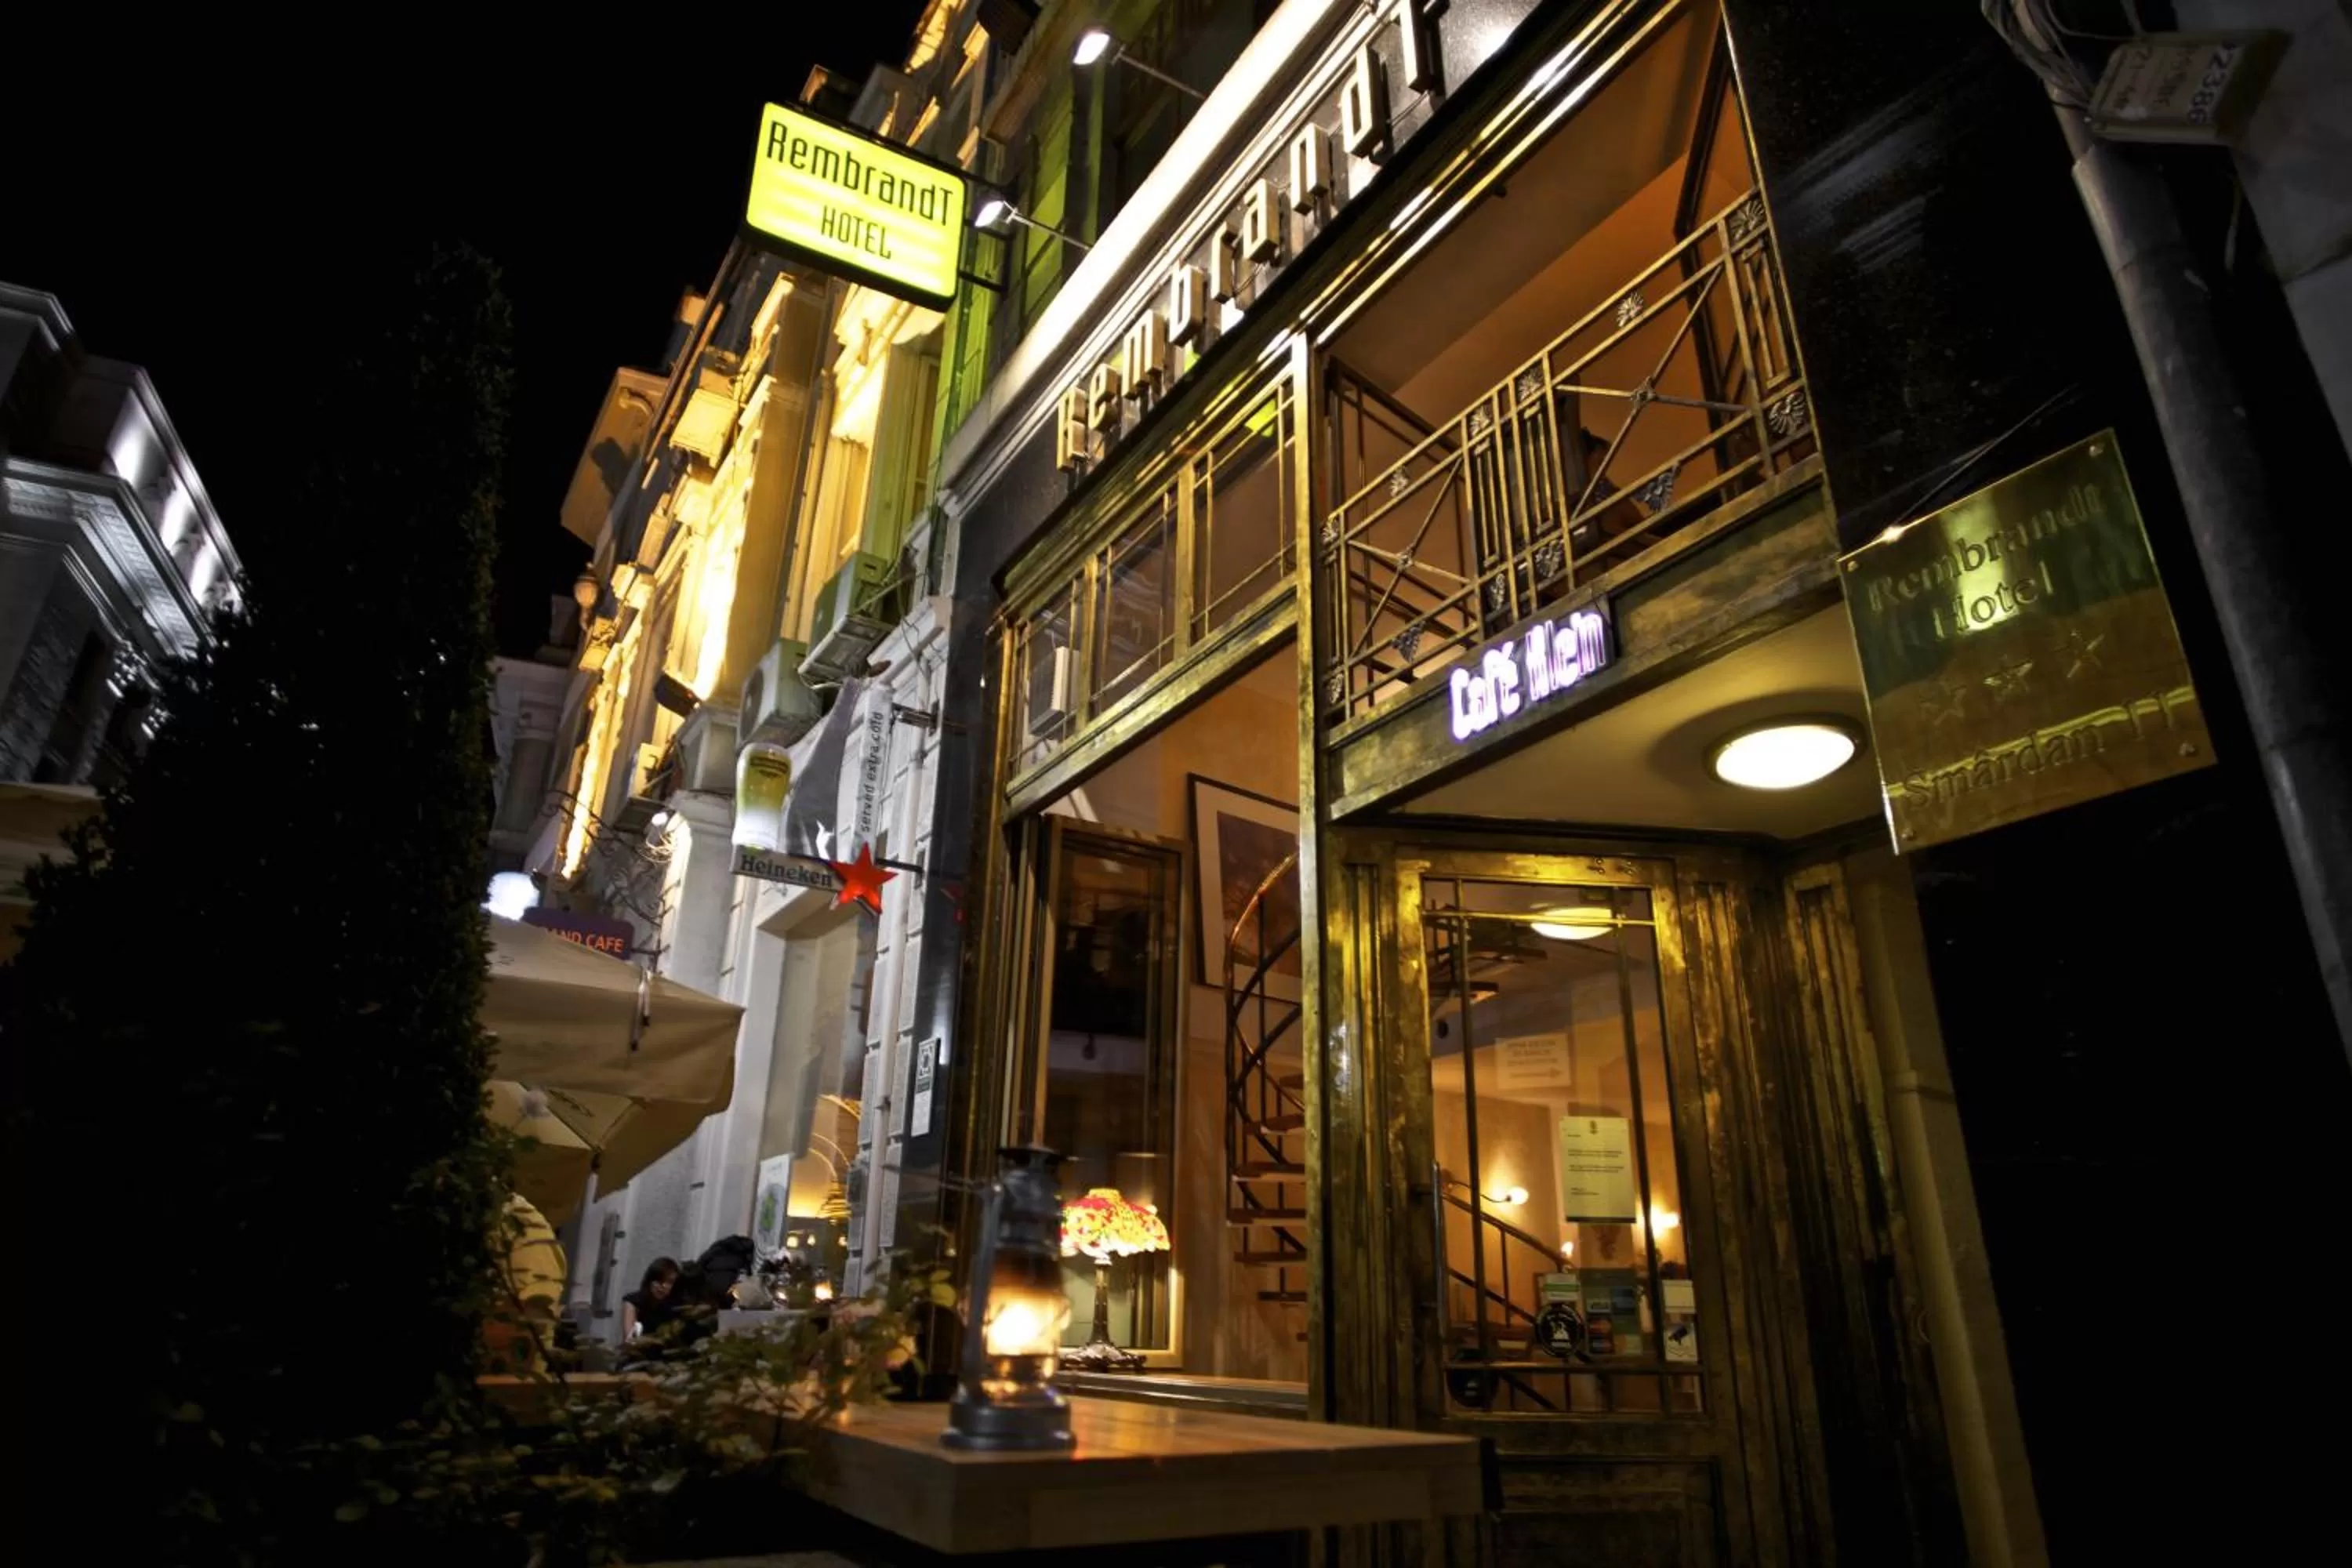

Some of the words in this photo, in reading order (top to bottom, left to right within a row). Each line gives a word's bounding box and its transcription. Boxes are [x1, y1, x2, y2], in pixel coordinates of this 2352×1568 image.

[821, 205, 891, 260] HOTEL
[1933, 561, 2054, 639] Hotel
[871, 711, 884, 742] cold
[2123, 694, 2173, 740] 11
[866, 746, 879, 781] extra
[860, 785, 874, 833] served
[740, 853, 832, 886] Heineken
